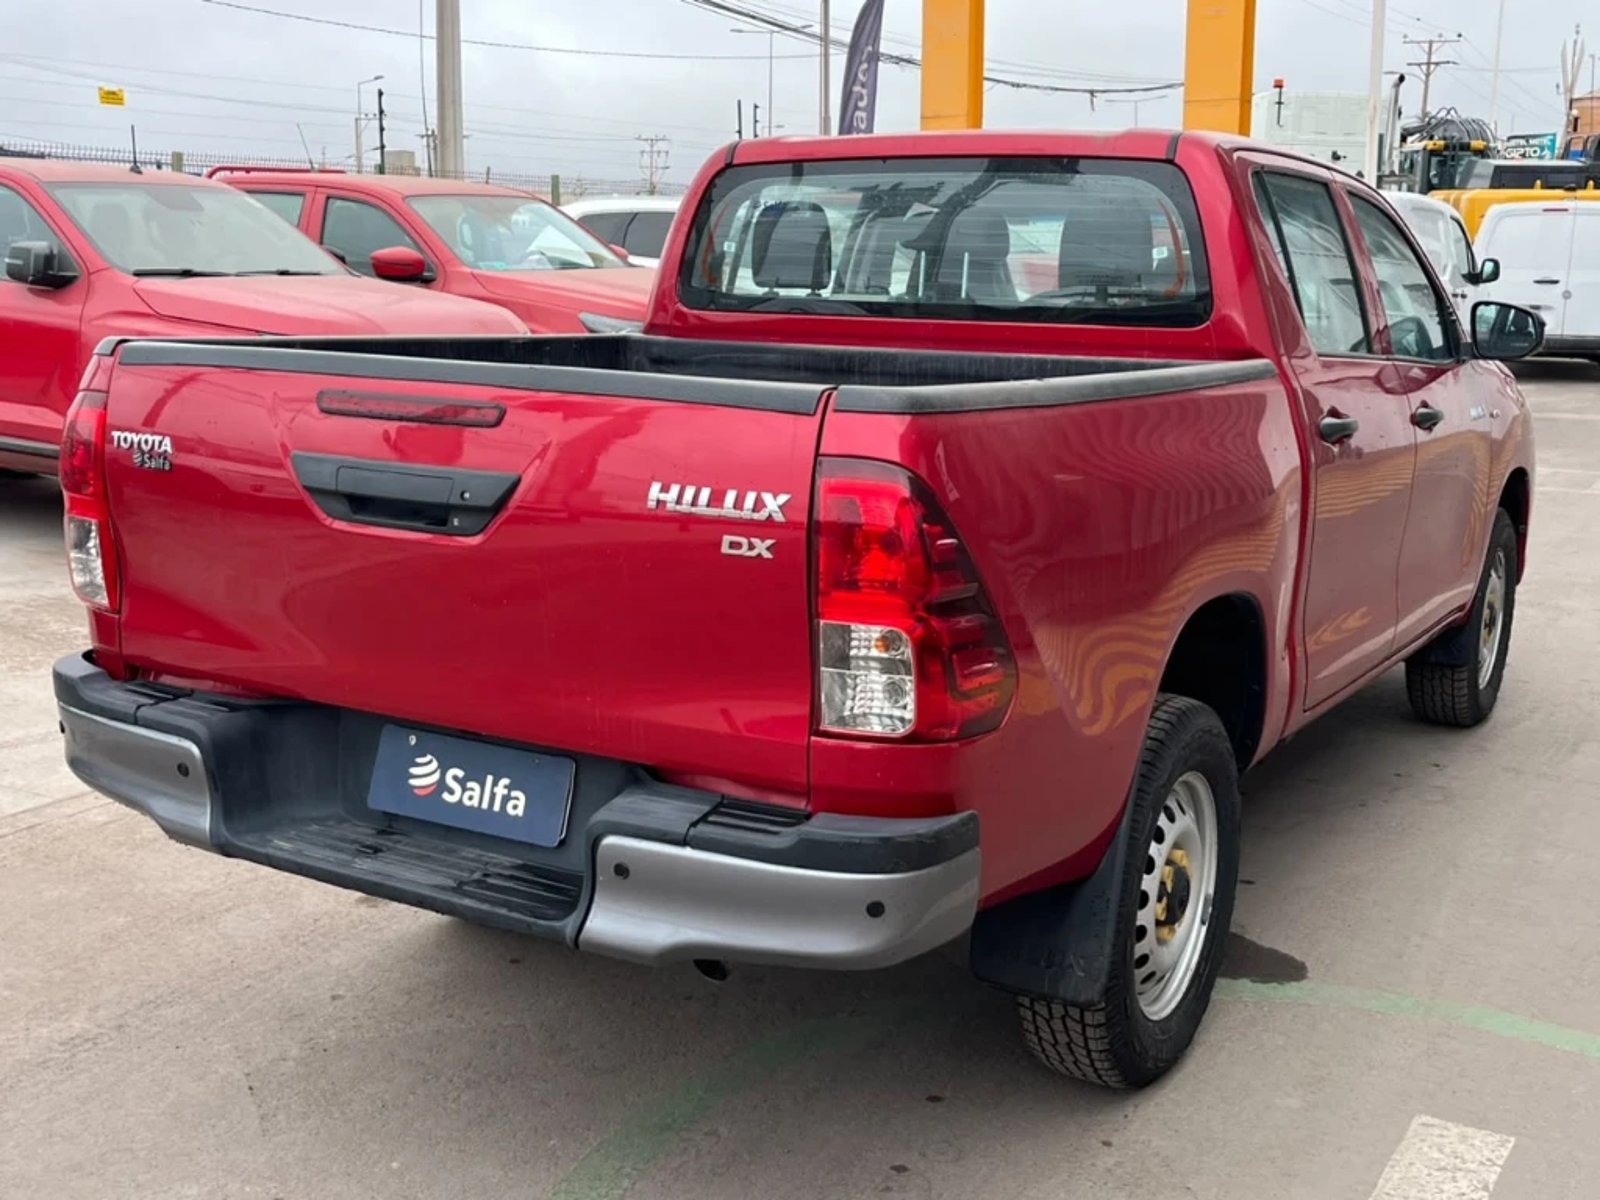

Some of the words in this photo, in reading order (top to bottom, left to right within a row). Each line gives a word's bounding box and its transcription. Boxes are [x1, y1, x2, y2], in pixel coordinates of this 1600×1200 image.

[110, 430, 173, 454] TOYOTA
[143, 453, 171, 471] Salfa
[646, 481, 792, 523] HILUX
[721, 534, 776, 559] DX
[441, 767, 526, 818] Salfa
